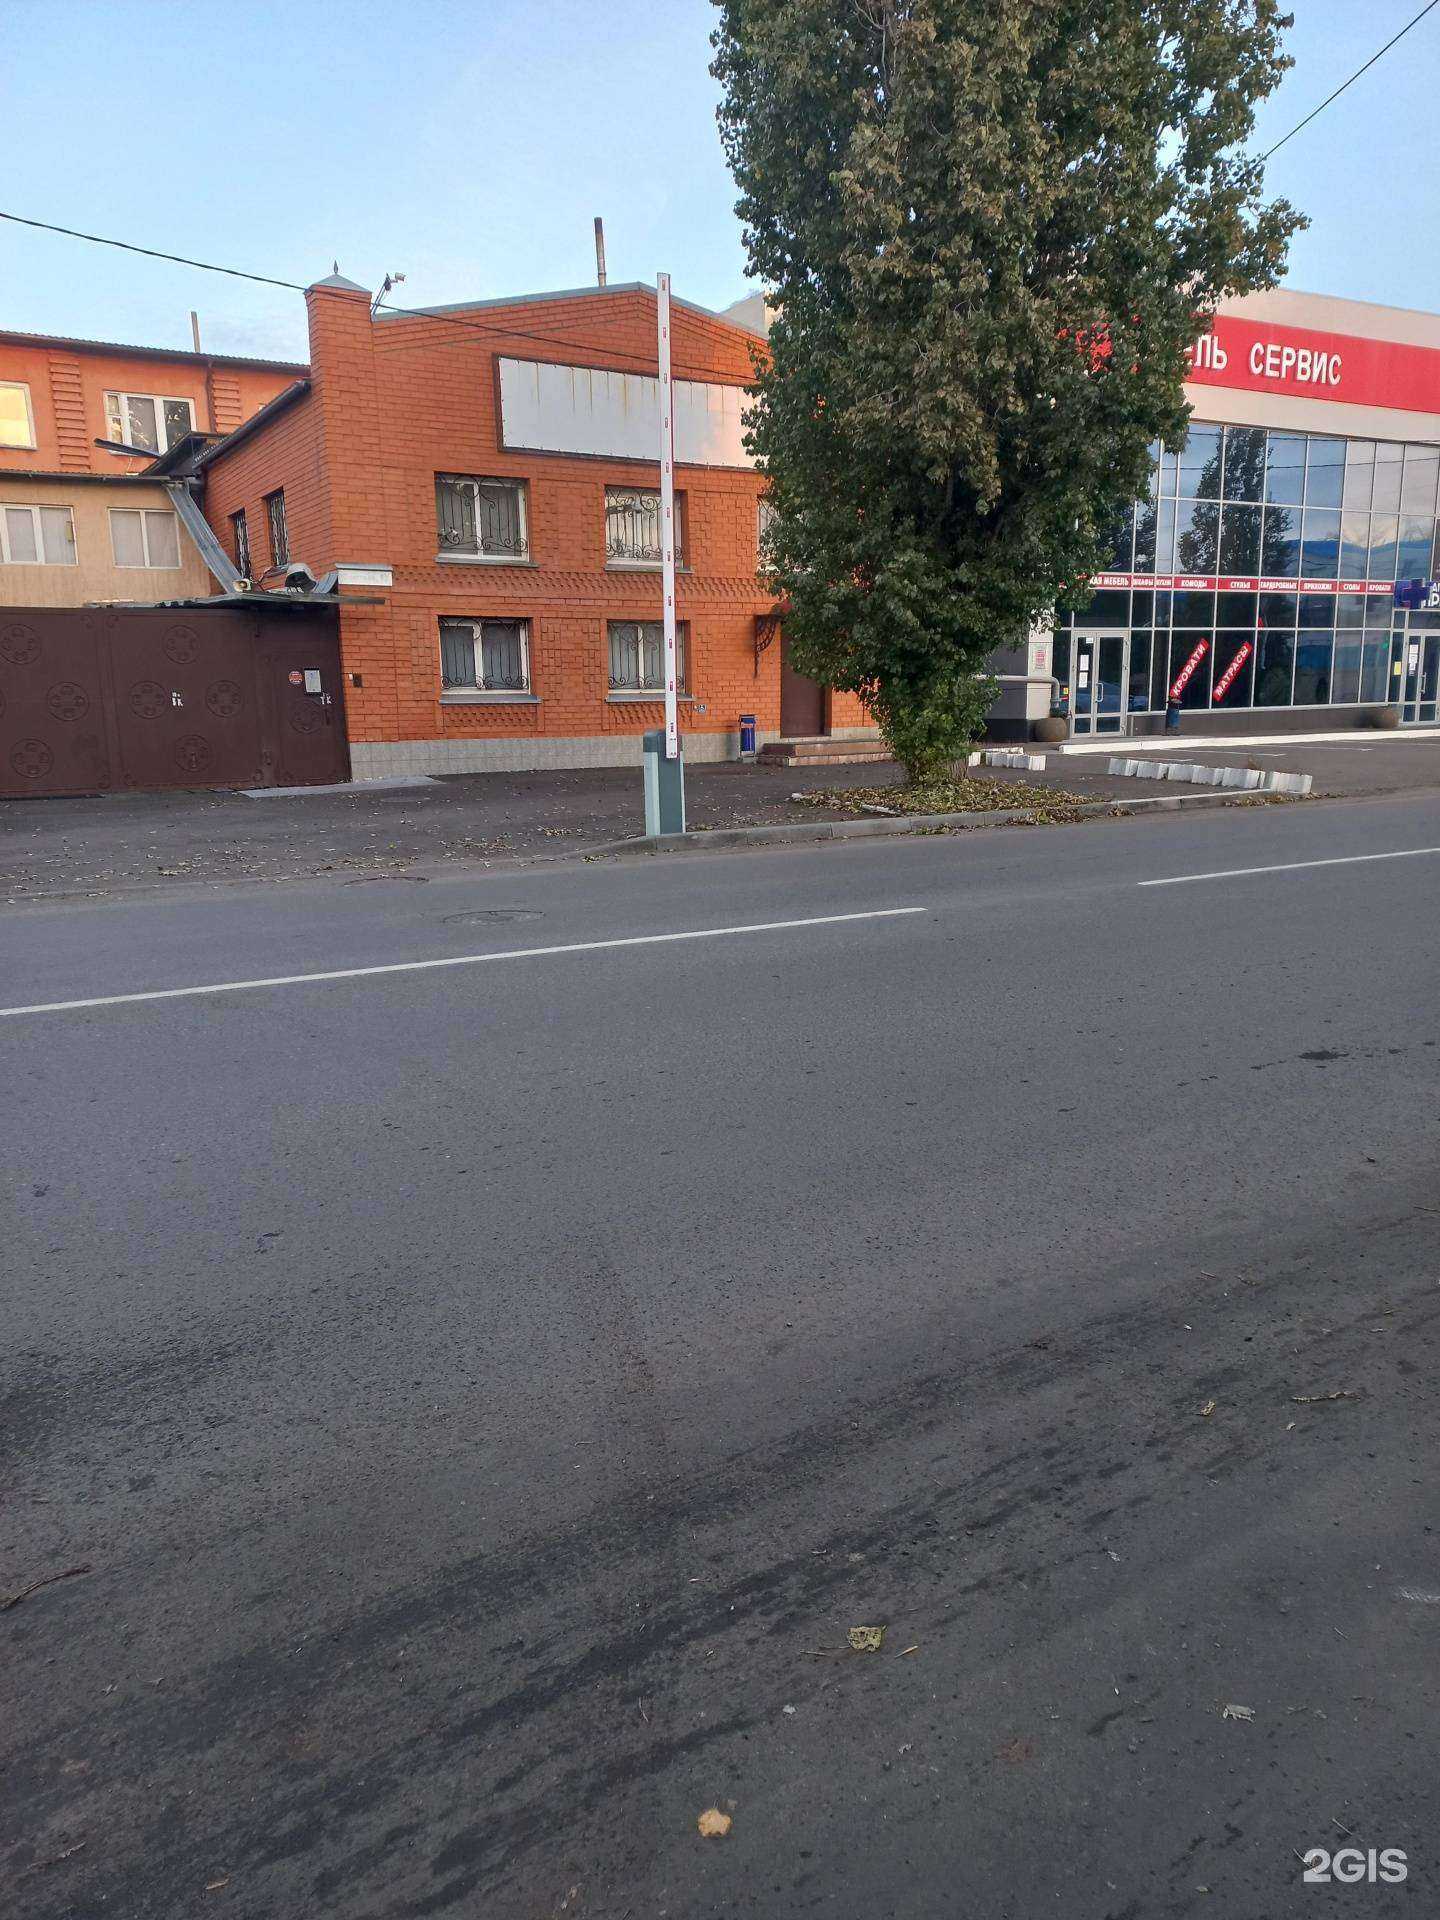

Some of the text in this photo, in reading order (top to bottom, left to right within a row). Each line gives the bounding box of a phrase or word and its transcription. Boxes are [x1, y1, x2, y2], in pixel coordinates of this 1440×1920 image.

[1250, 342, 1342, 386] СЕРВИС
[1103, 577, 1129, 586] МЕБЕЛЬ
[1181, 580, 1207, 588] КОМОДЫ
[1173, 644, 1206, 696] КРОВАТИ
[1217, 646, 1249, 696] МАТРАСЫ
